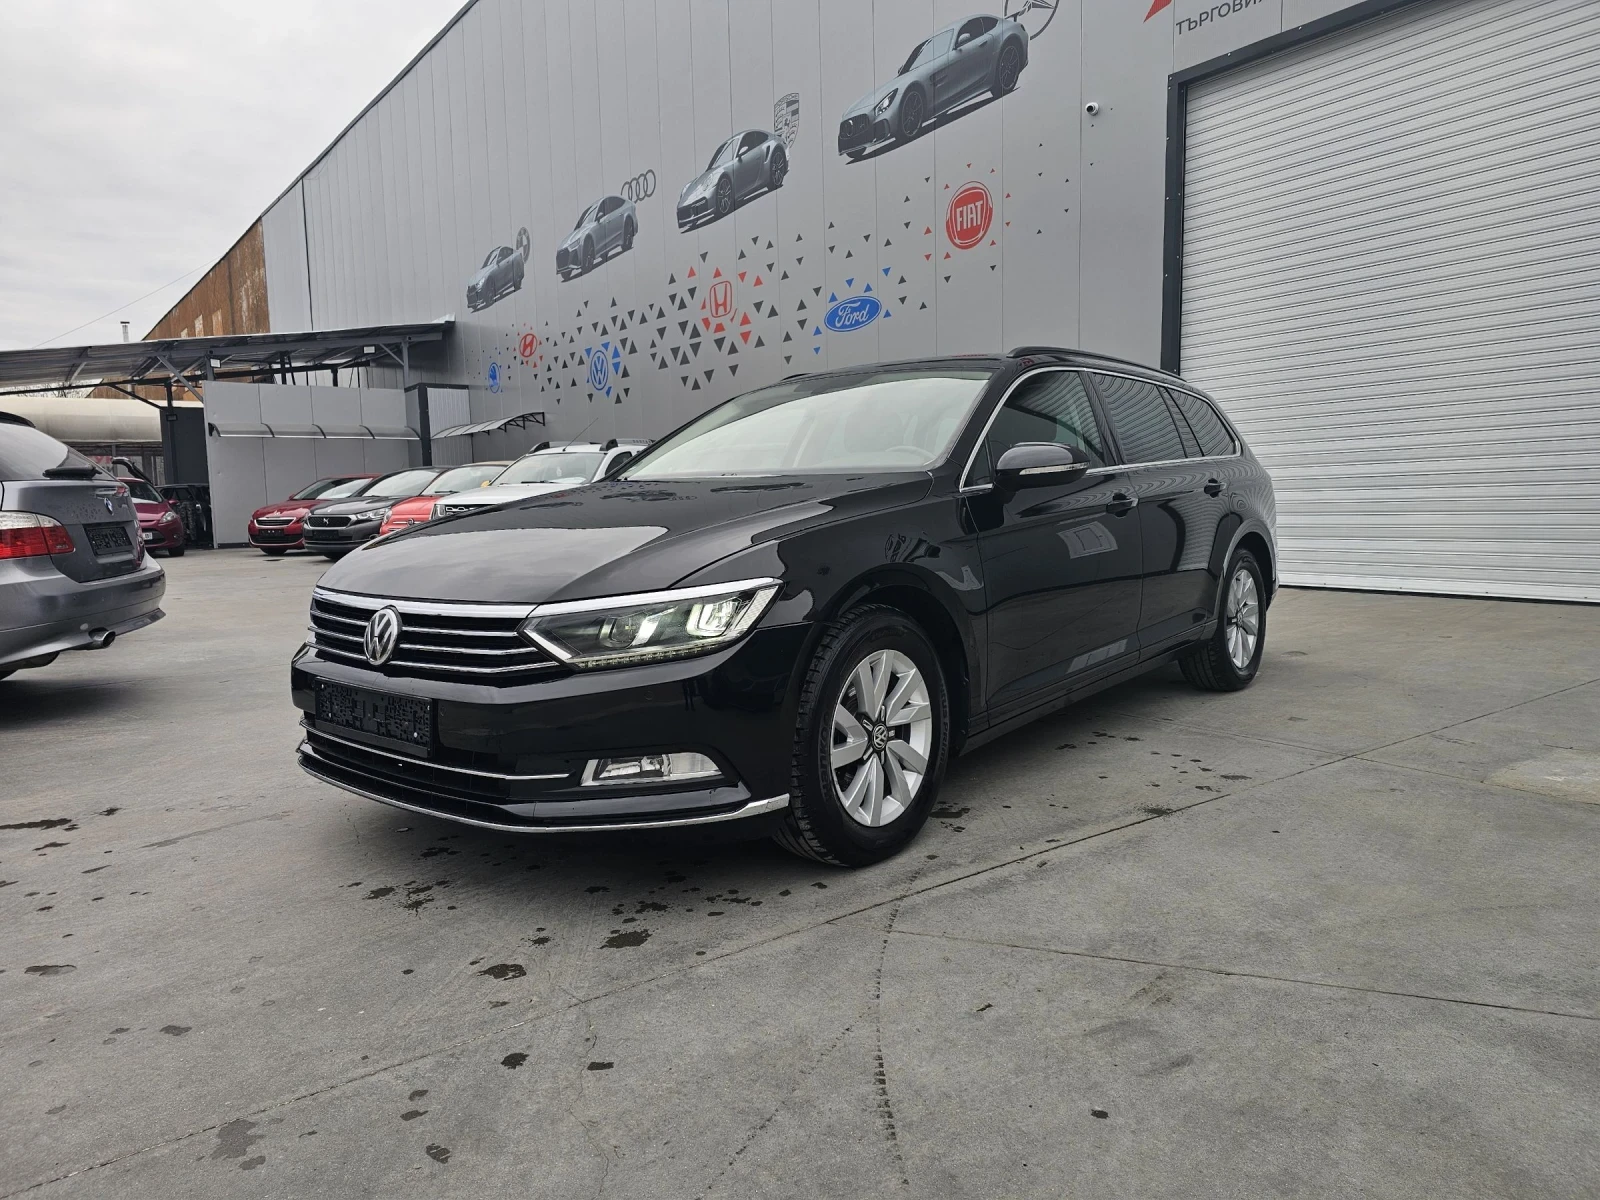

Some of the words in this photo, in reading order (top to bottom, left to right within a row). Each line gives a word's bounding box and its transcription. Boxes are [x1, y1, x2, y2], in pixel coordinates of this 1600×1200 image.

[1176, 0, 1262, 35] ТЪРГОВ
[956, 200, 984, 231] FIAT
[835, 301, 870, 327] Ford
